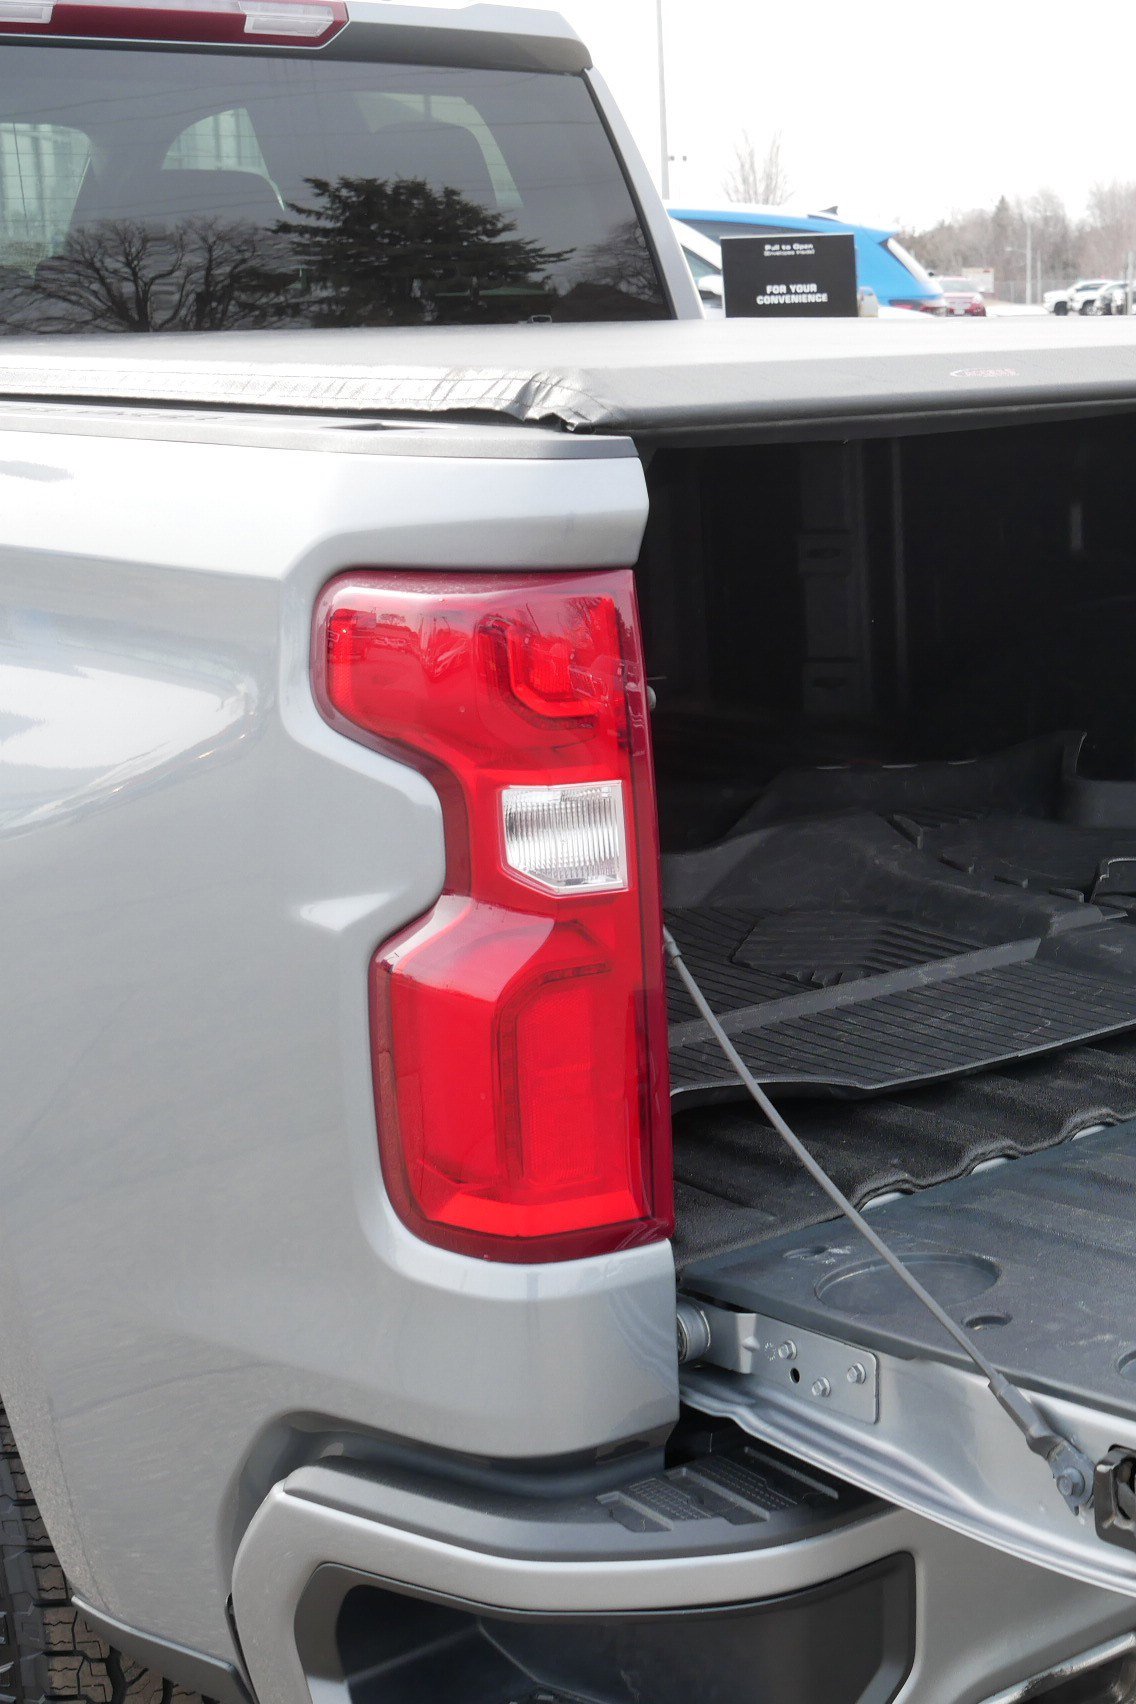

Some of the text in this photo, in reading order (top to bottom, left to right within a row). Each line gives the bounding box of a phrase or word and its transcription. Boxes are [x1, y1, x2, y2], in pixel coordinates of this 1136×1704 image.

[766, 283, 818, 294] FOR YOUR
[756, 293, 829, 305] CONVENIENCE
